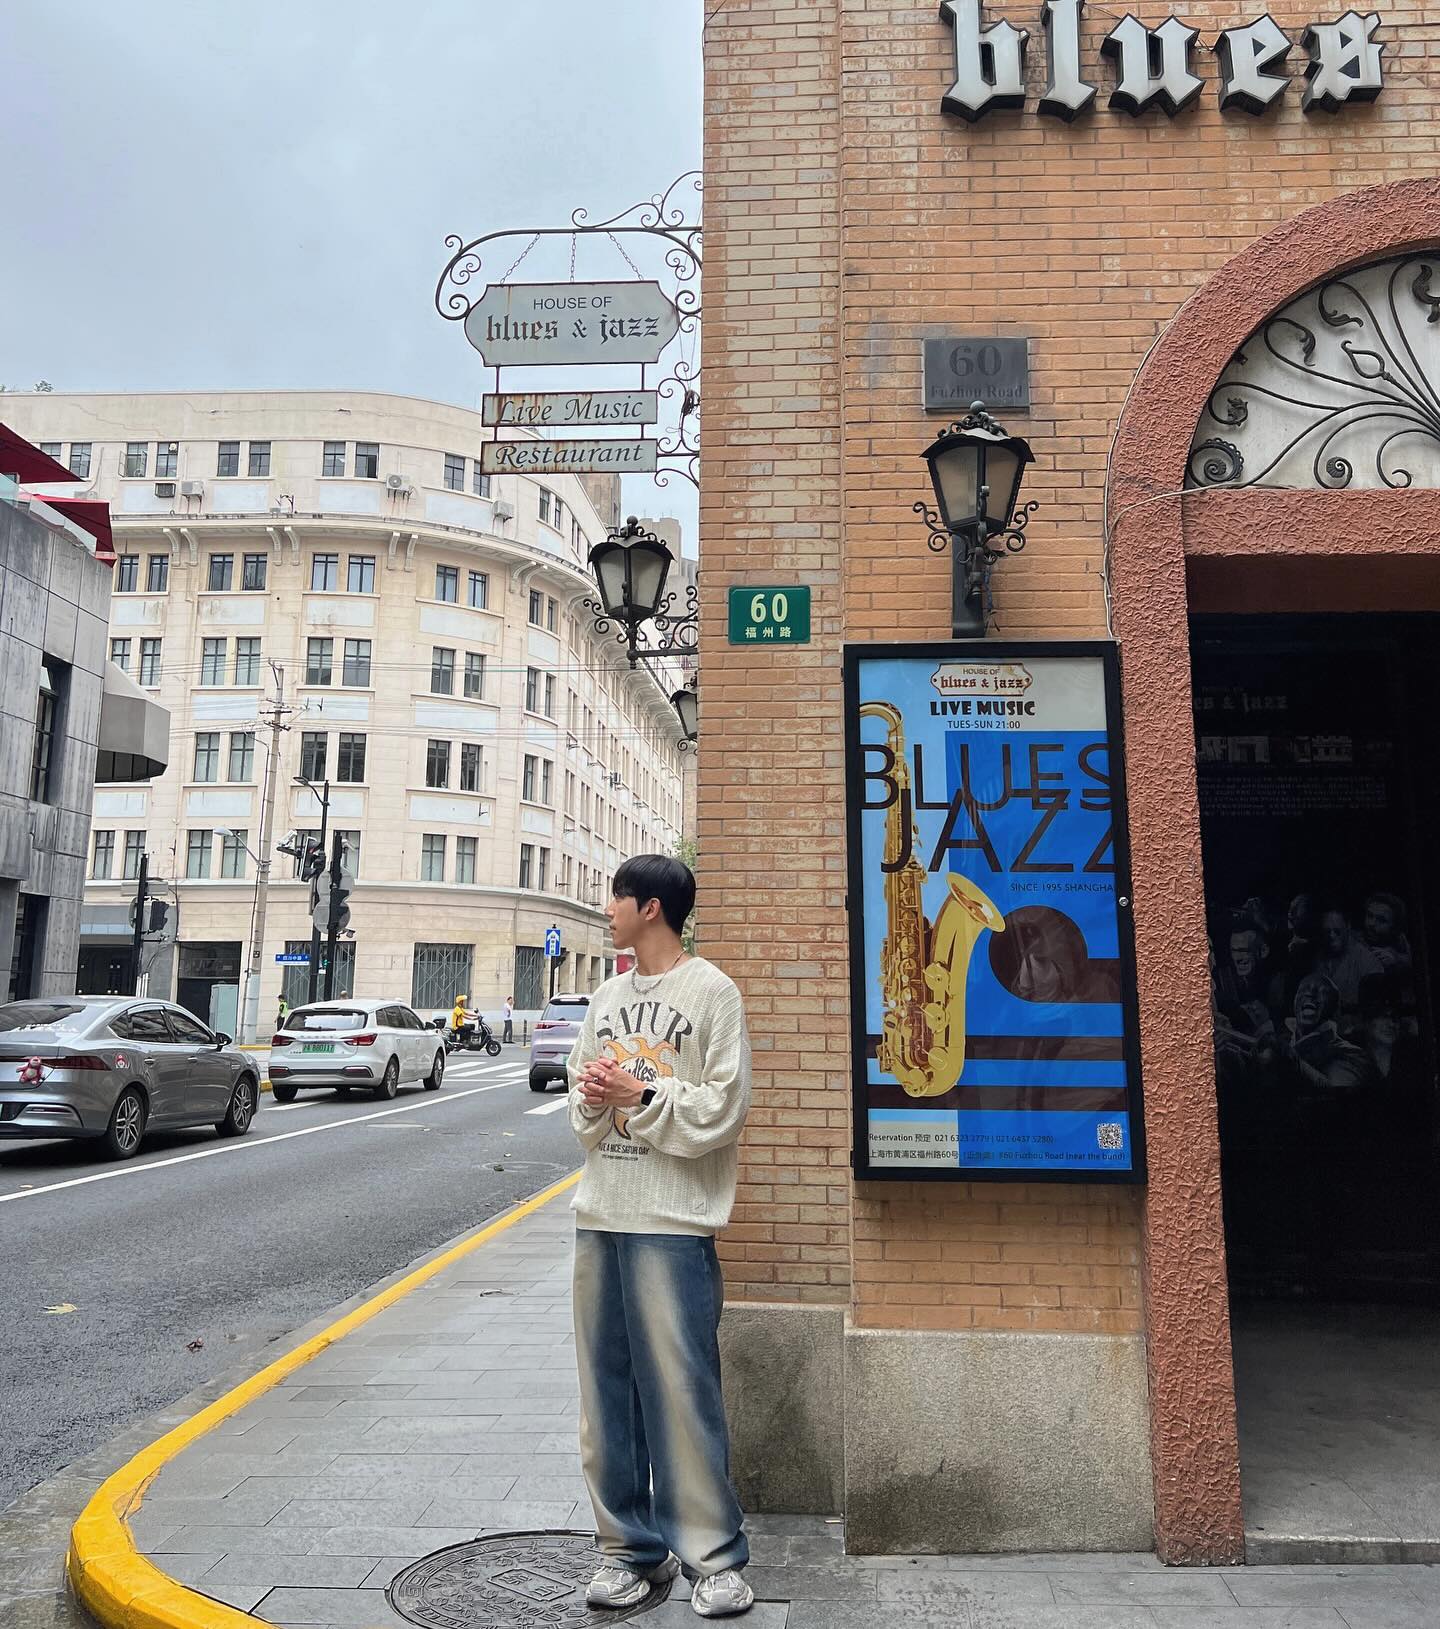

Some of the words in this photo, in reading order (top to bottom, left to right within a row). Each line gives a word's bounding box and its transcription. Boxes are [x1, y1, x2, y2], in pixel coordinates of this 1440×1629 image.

[939, 0, 1384, 122] blues
[533, 297, 587, 310] HOUSE
[591, 296, 613, 309] OF
[486, 314, 559, 342] blues
[572, 318, 588, 339] &
[599, 314, 660, 344] jazz
[949, 345, 1002, 377] 60
[930, 385, 981, 399] Fuzhou
[986, 384, 1023, 399] Road
[498, 400, 553, 423] Live
[564, 395, 643, 421] Music
[495, 444, 644, 469] Restaurant
[750, 593, 788, 623] 60
[745, 626, 792, 639] 福州路
[940, 675, 977, 689] blues
[981, 677, 989, 688] &
[994, 676, 1024, 692] jazz
[930, 701, 972, 716] LIVE
[976, 701, 1035, 716] MUSIC
[947, 720, 993, 729] TUES-SUN
[995, 720, 1021, 729] 21:00
[859, 743, 1113, 812] BLUES
[1010, 882, 1037, 892] SINCE
[1042, 883, 1062, 892] 1995
[868, 1133, 913, 1142] Reservation
[915, 1133, 931, 1143] 预定
[934, 1134, 948, 1142] 021
[1045, 1151, 1064, 1160] Road
